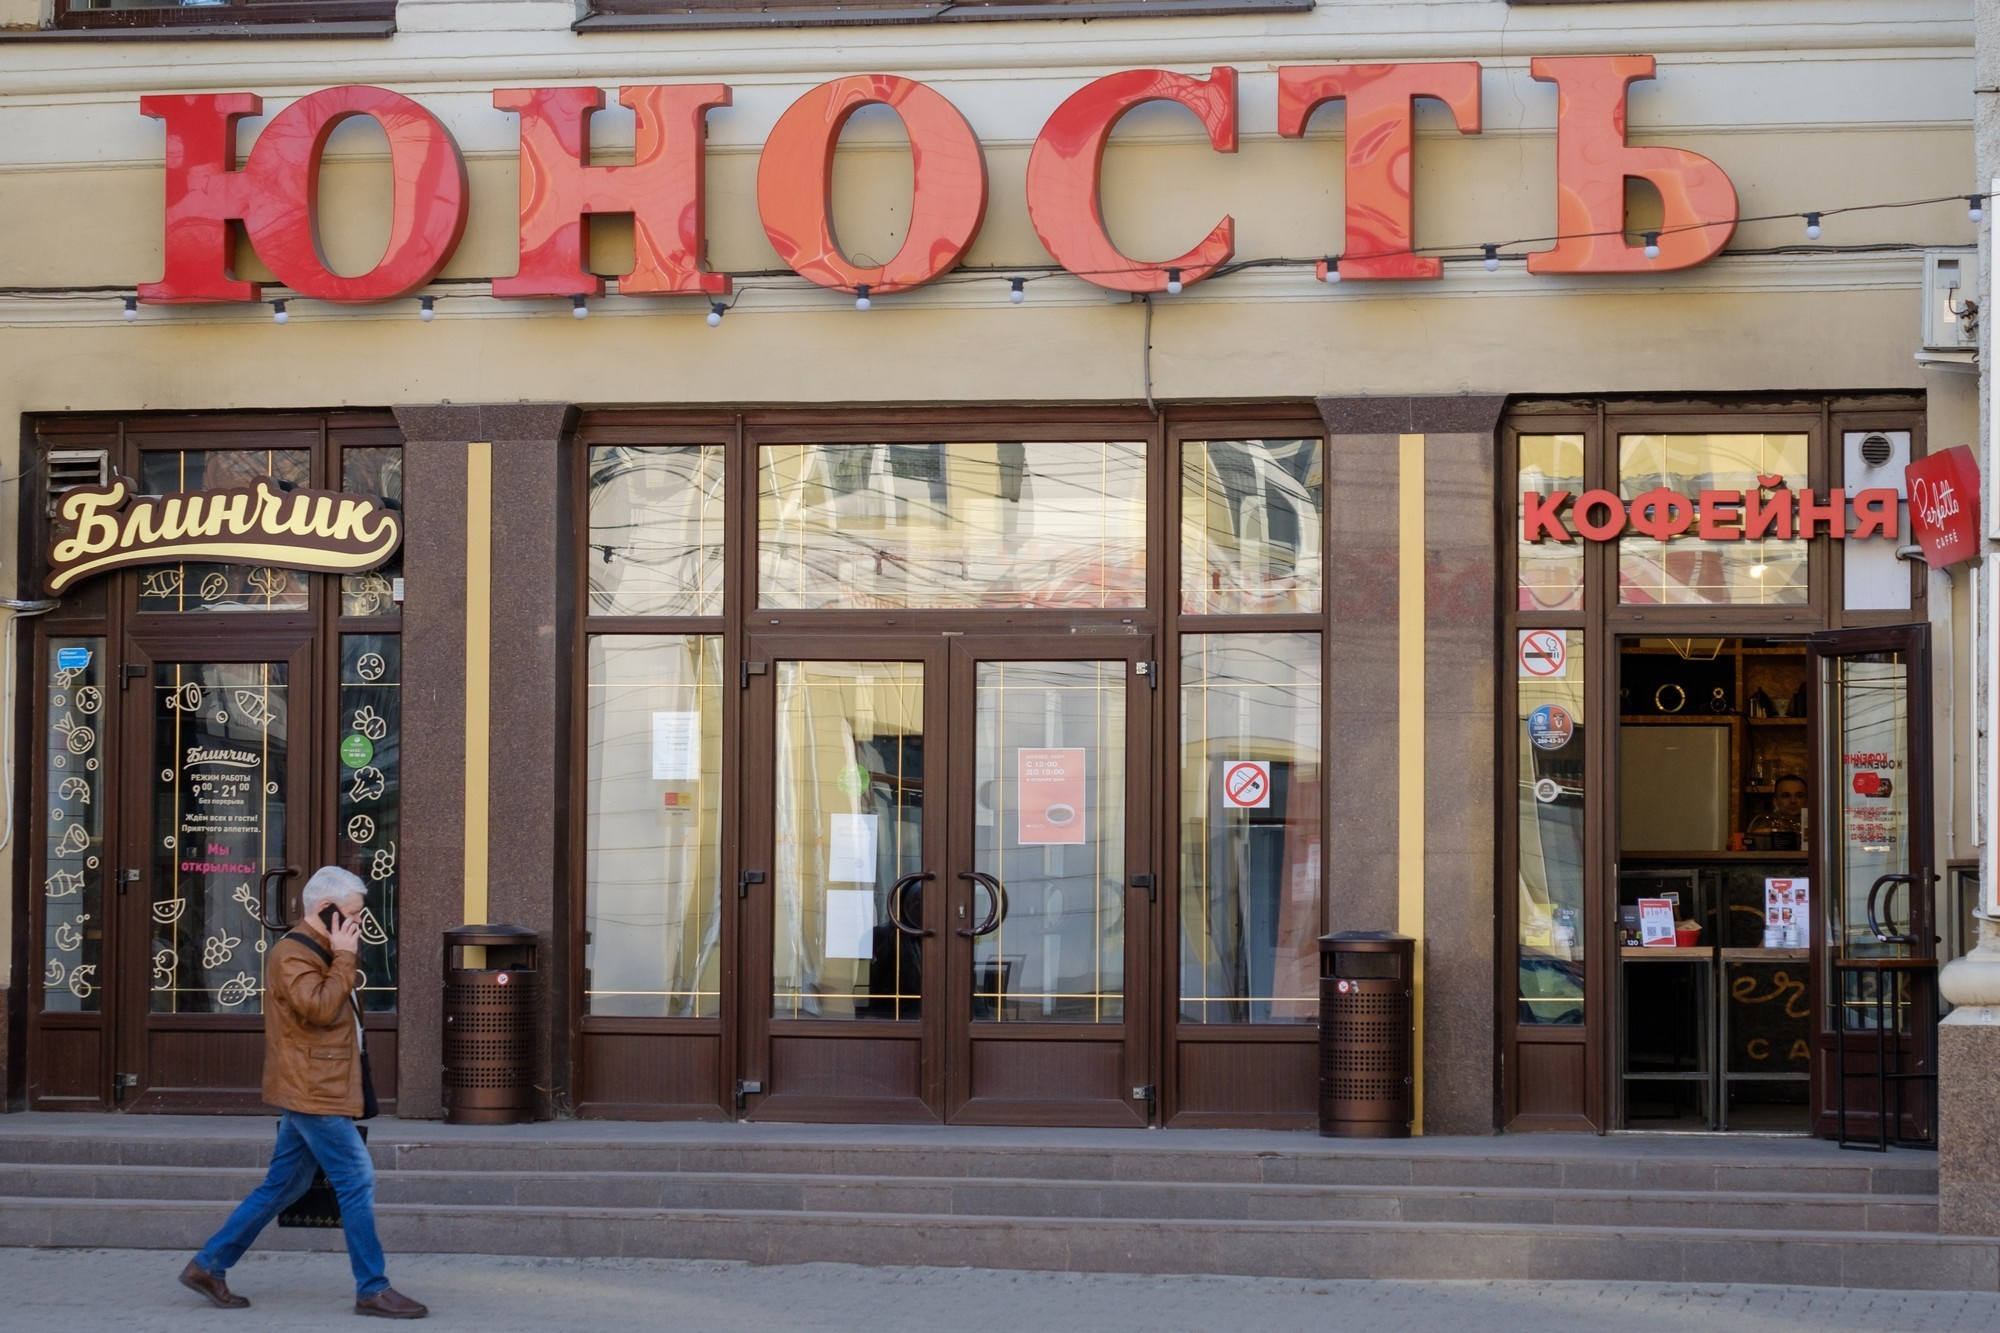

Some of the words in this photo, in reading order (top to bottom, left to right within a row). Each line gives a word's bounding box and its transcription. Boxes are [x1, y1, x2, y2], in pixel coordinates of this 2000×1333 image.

[137, 55, 1739, 304] ЮНОСТЬ
[1523, 474, 1898, 542] КОФЕЙНЯ
[1911, 478, 1960, 531] Perfetto
[51, 482, 398, 590] Блинчик
[183, 745, 261, 770] Блинчик
[185, 813, 209, 822] Ждём
[181, 862, 256, 874] открылись!
[207, 843, 230, 855] Мы
